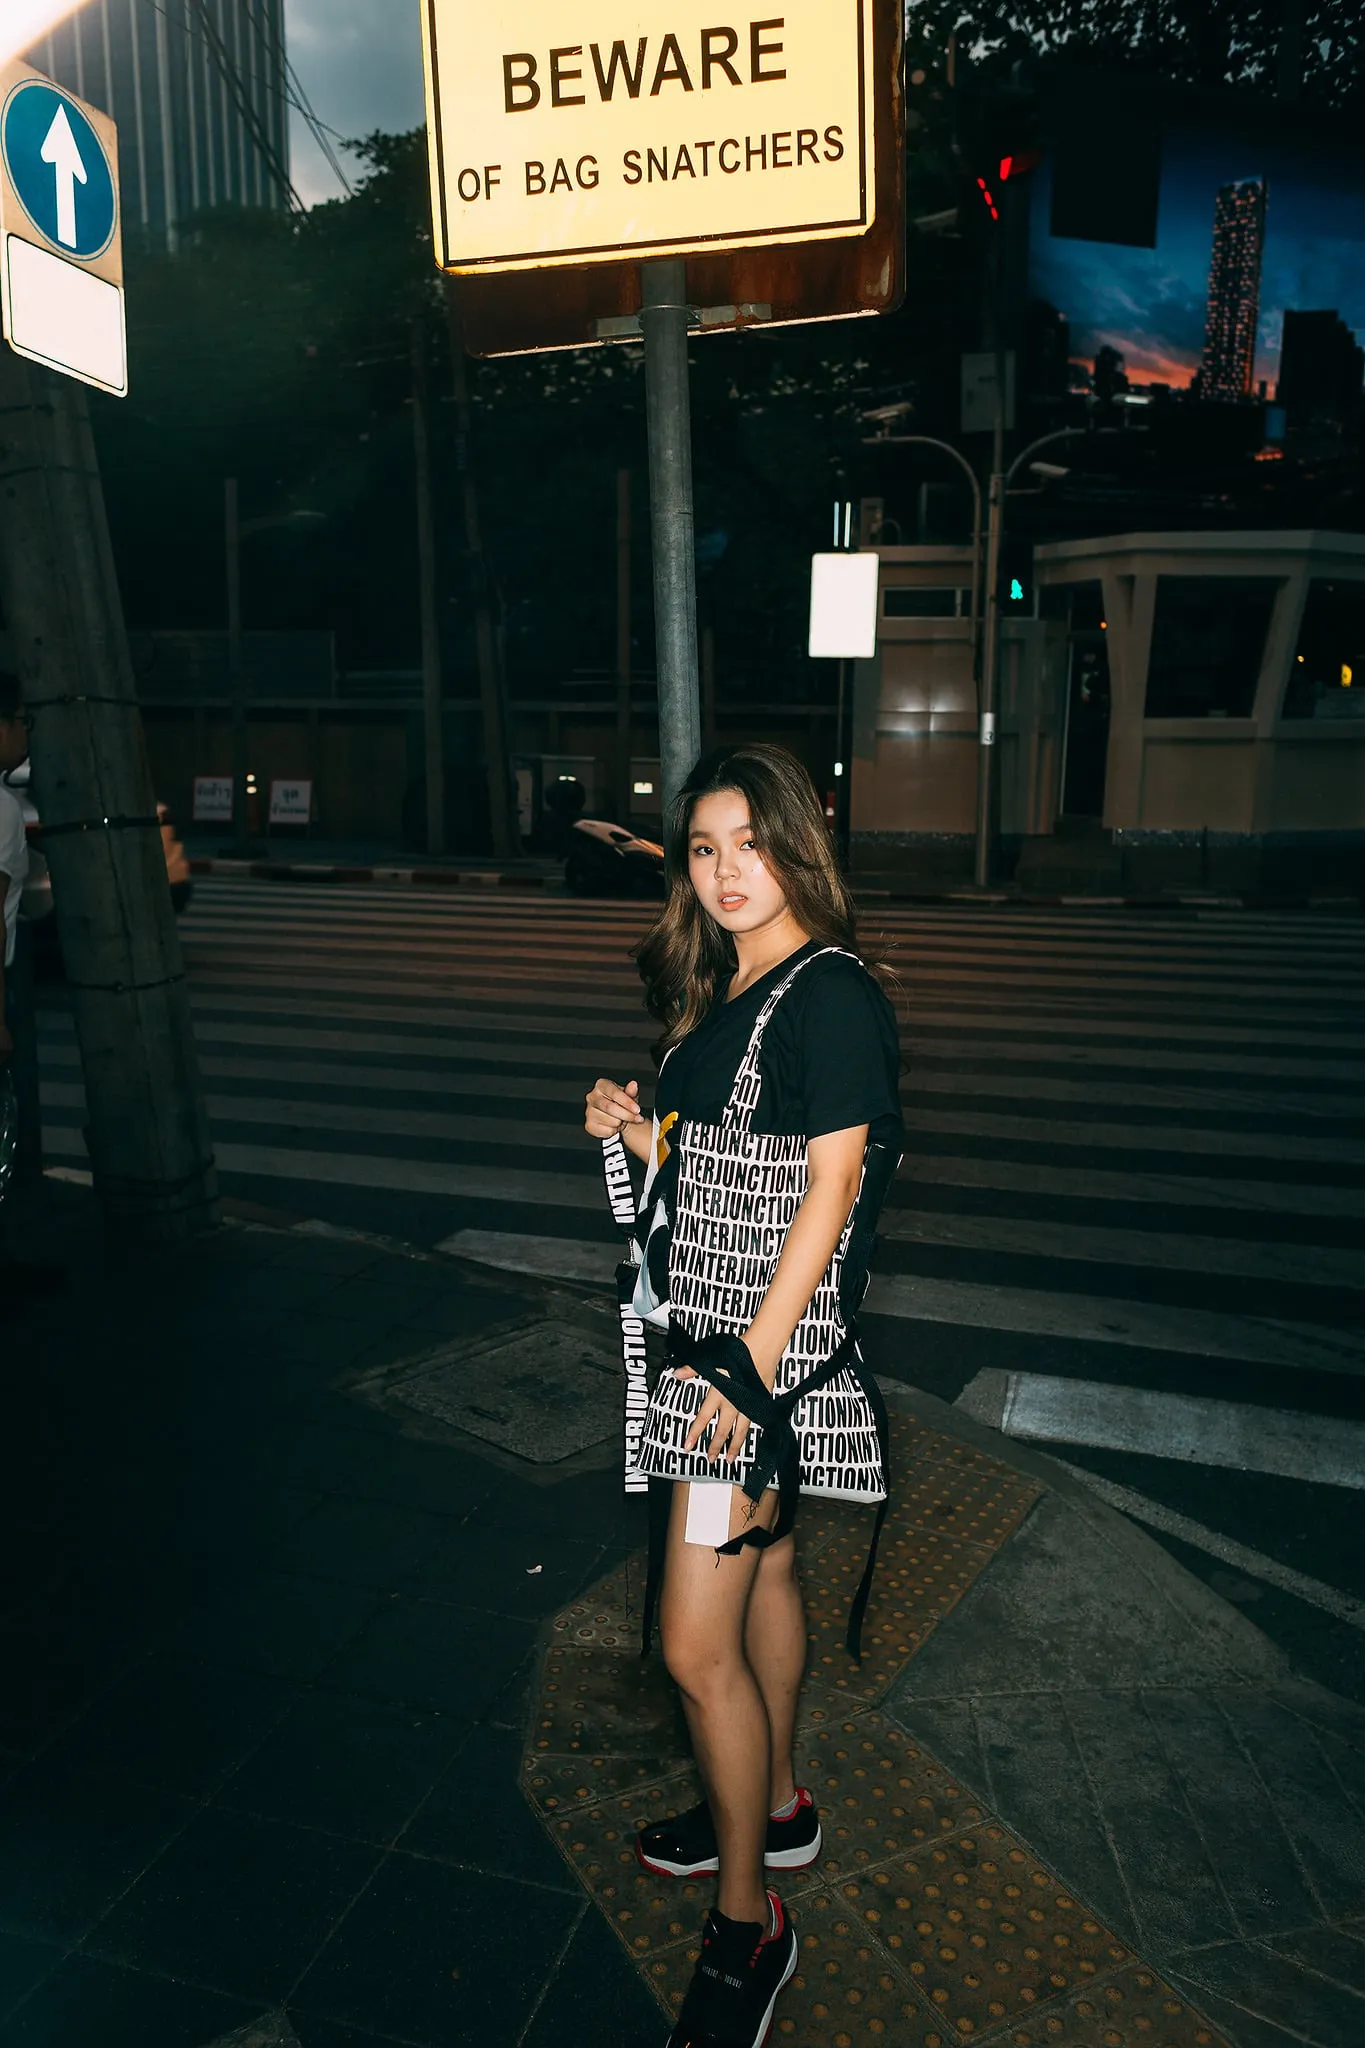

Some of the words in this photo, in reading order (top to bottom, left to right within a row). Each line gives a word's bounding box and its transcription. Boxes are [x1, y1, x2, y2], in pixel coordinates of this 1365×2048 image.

[502, 18, 787, 113] BEWARE
[458, 165, 502, 202] OF
[524, 155, 600, 196] BAG
[623, 125, 845, 185] SNATCHERS
